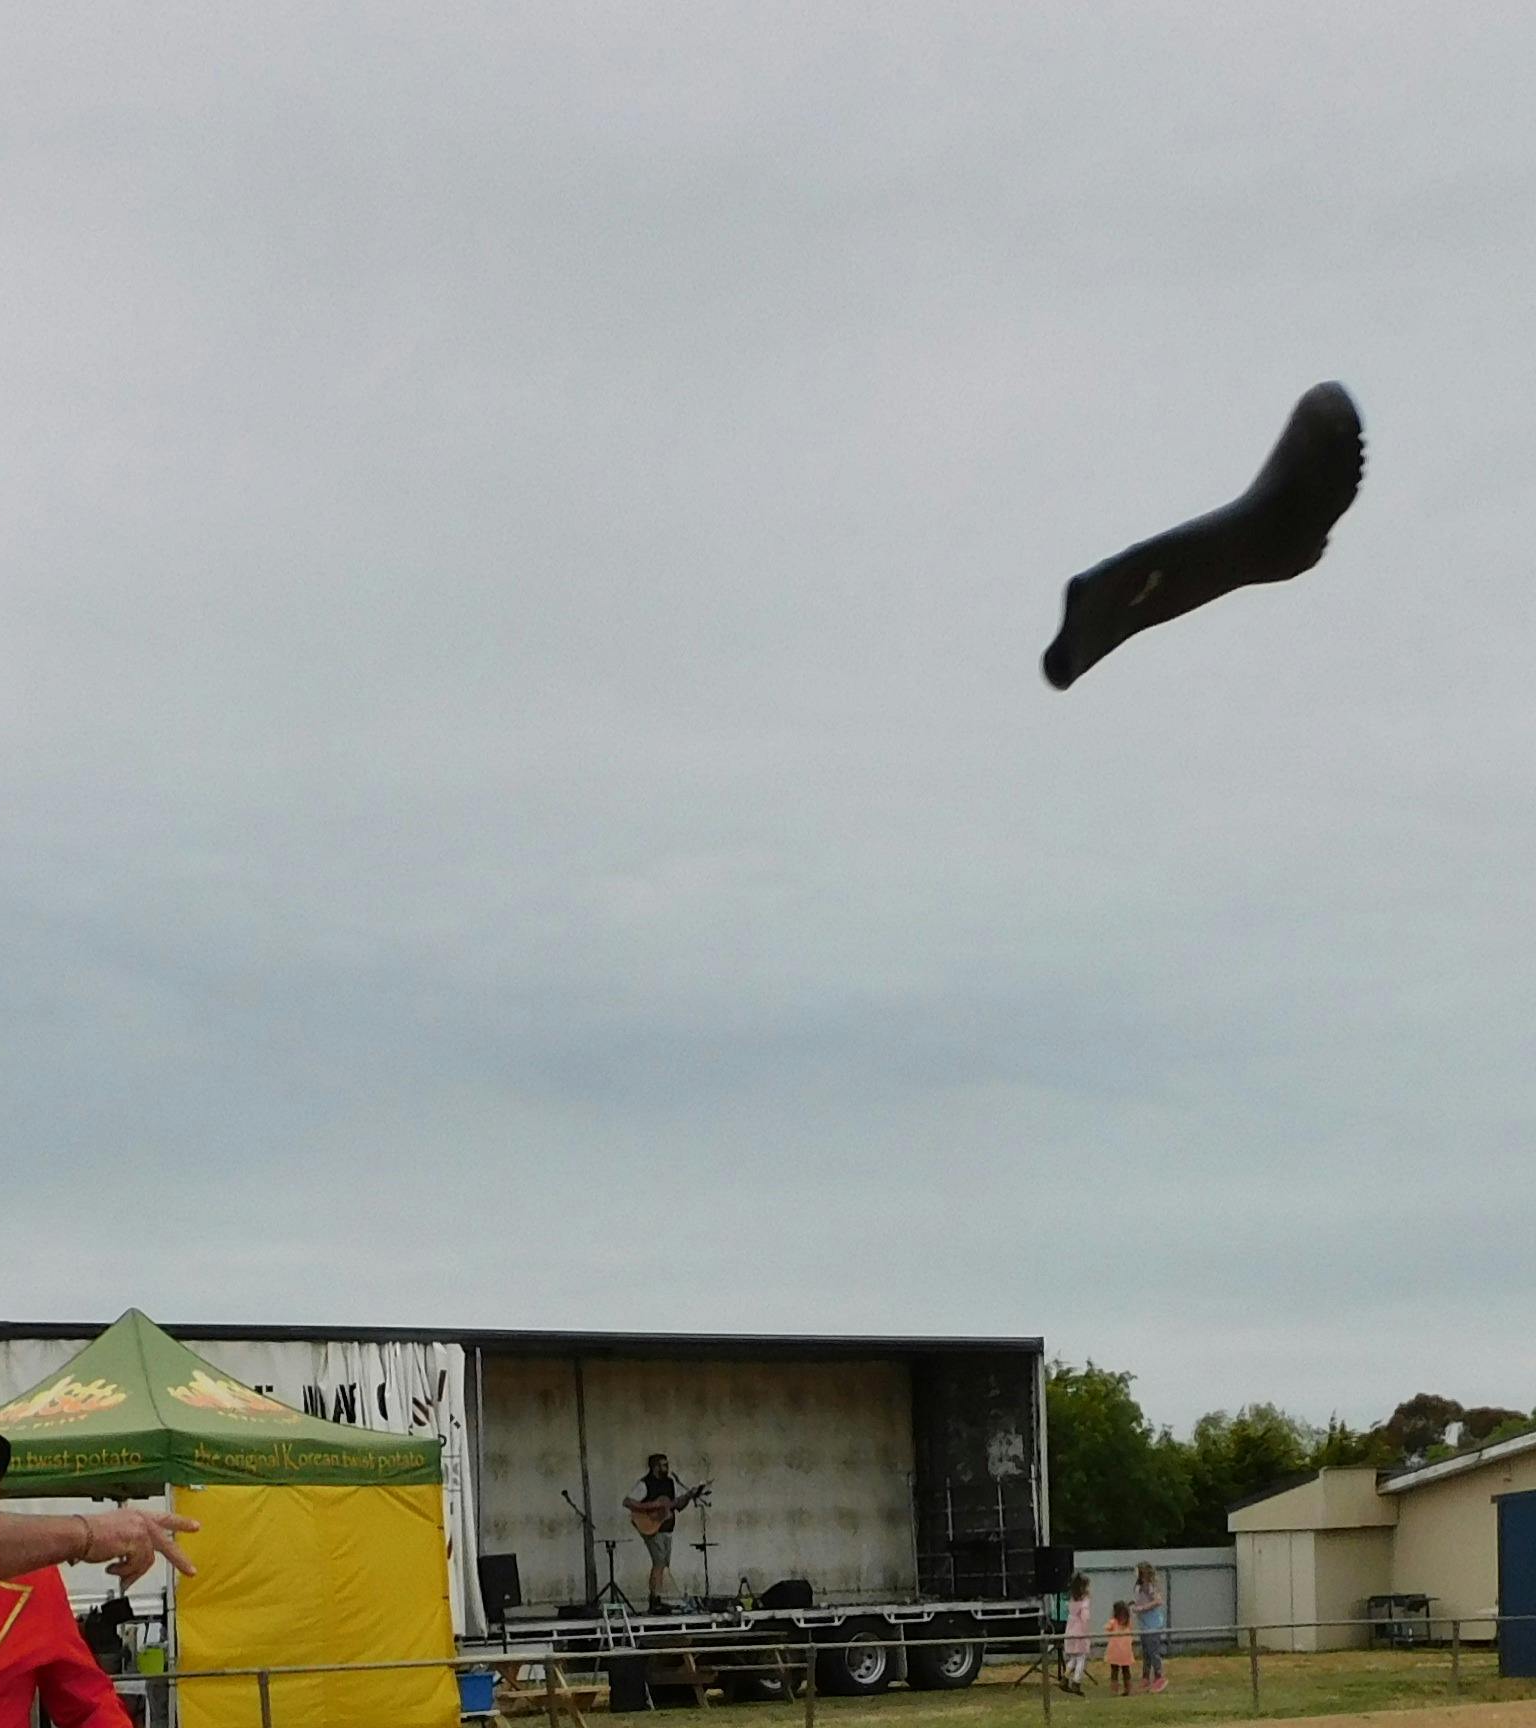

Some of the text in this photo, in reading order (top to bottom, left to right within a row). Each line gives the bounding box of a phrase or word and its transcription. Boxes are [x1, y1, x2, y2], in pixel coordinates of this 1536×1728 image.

[26, 1450, 68, 1467] twist
[75, 1447, 142, 1474] potato
[224, 1444, 280, 1475] original
[376, 1451, 425, 1475] potato
